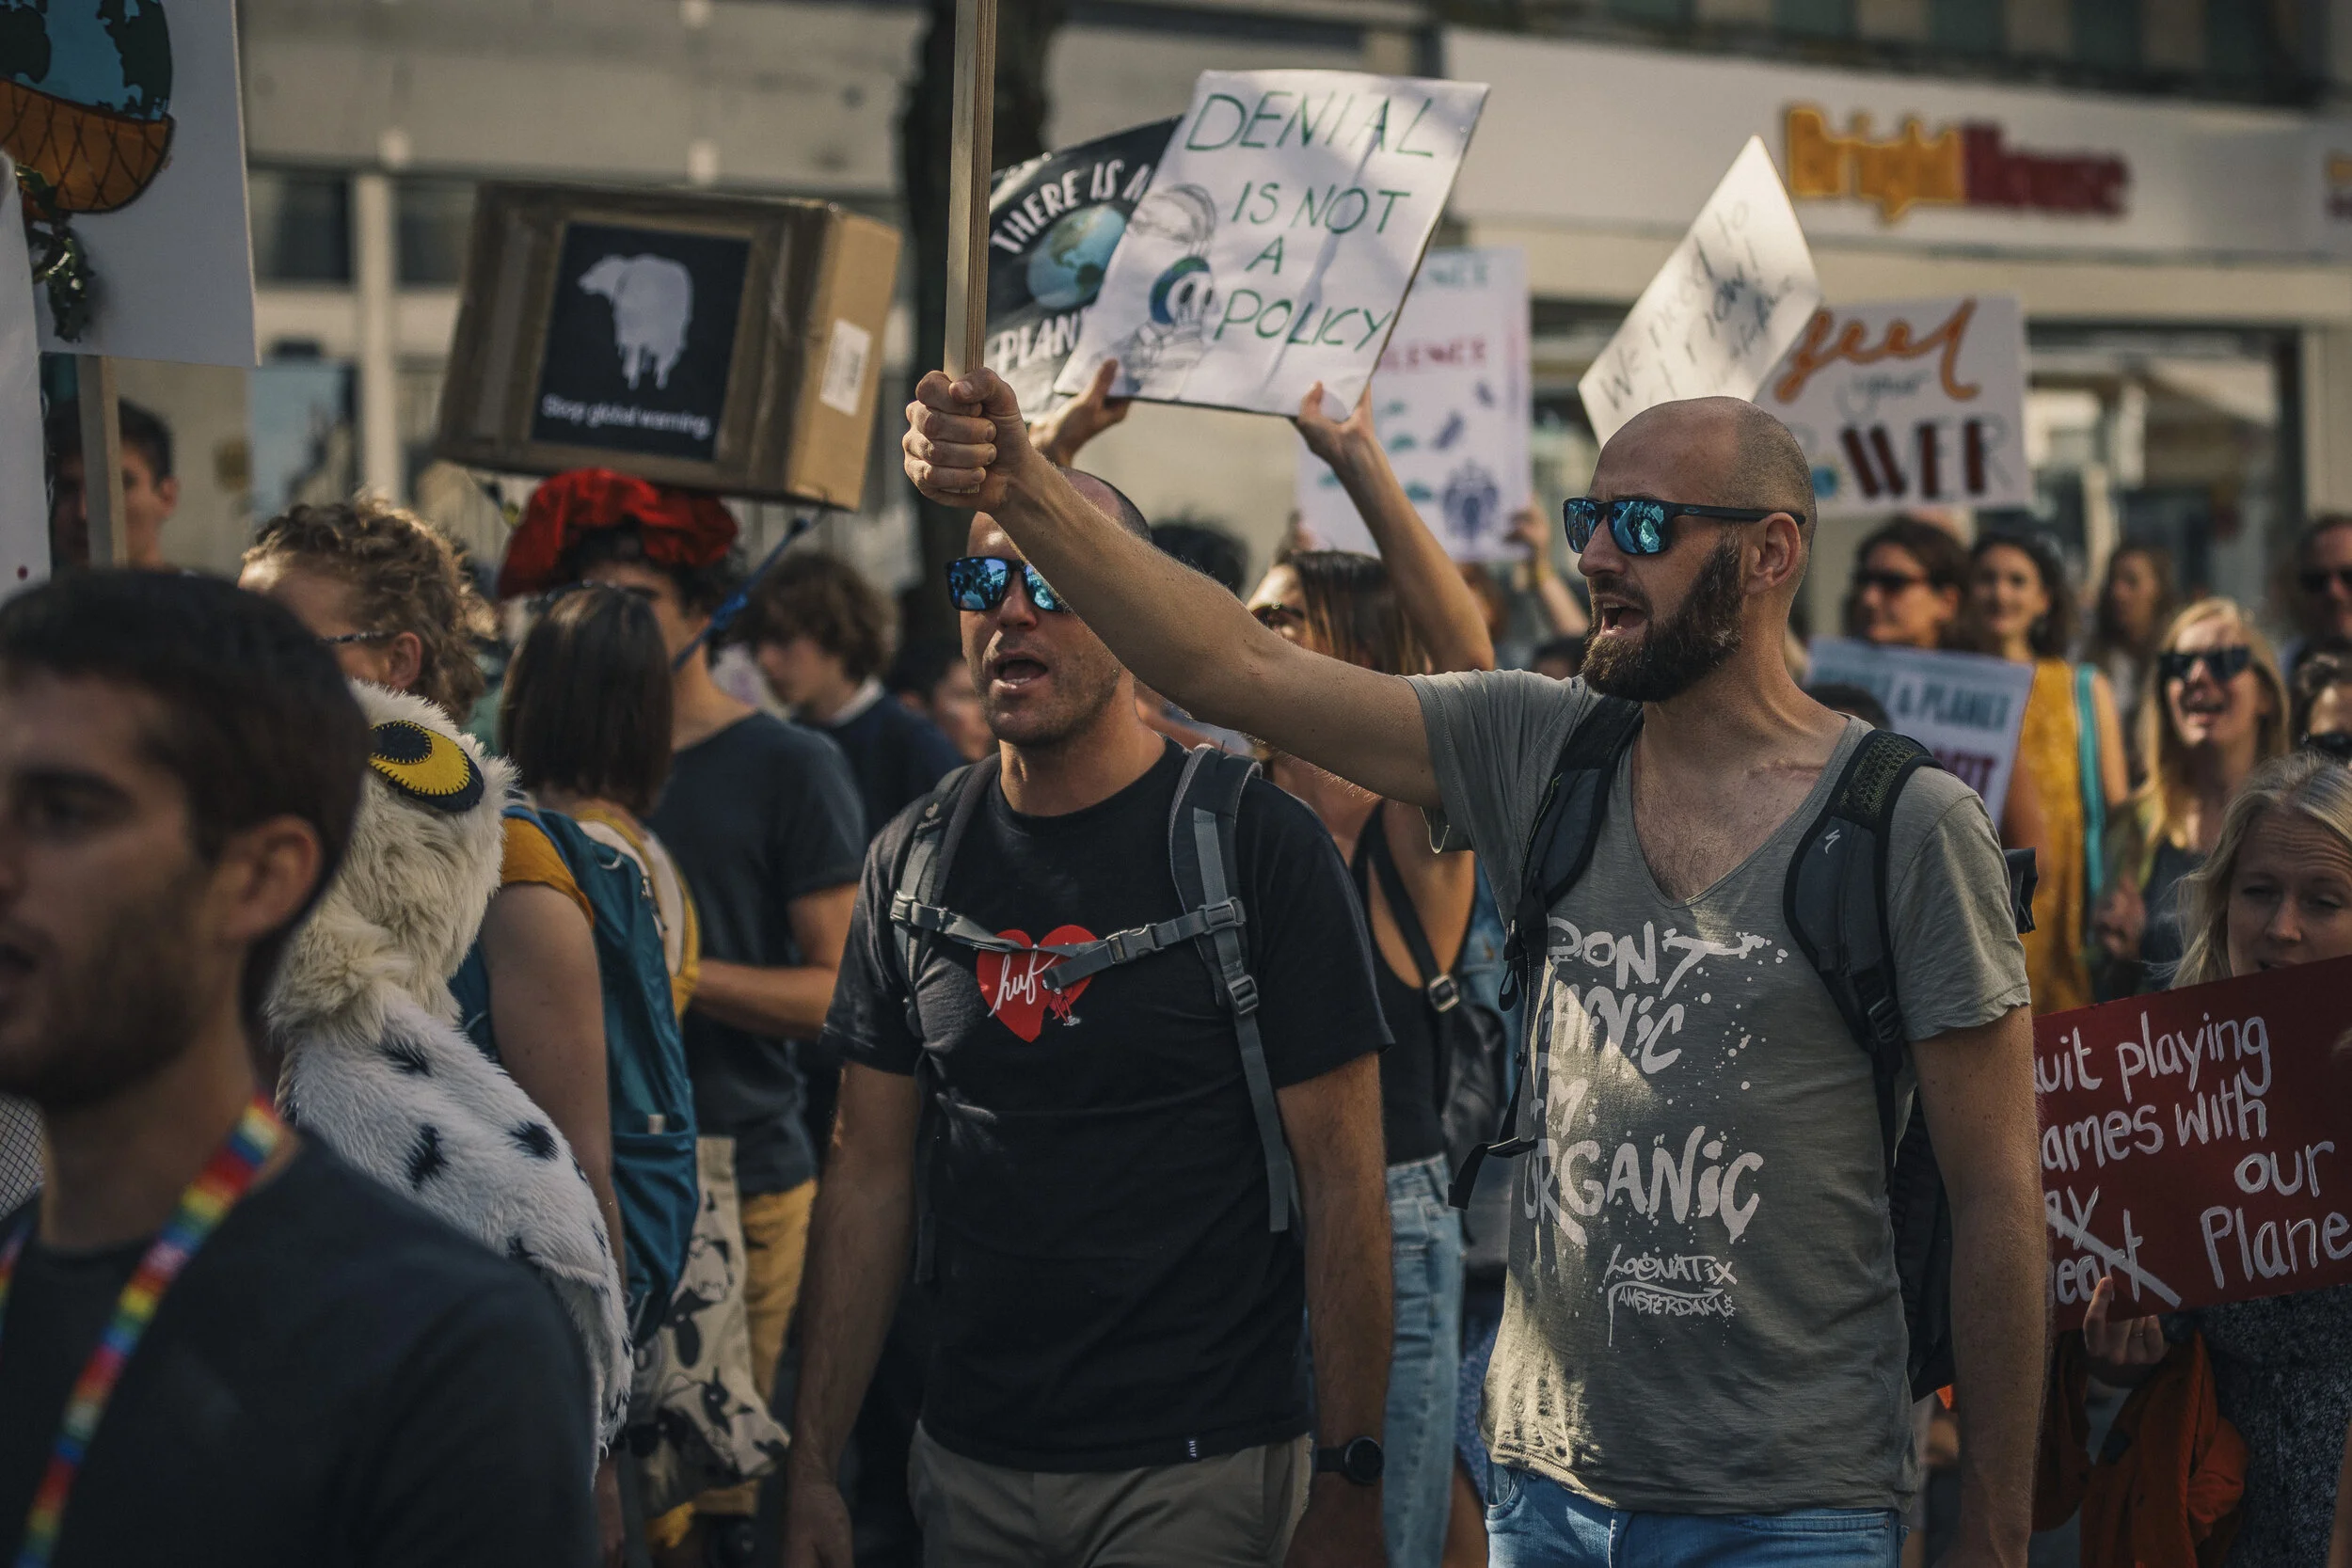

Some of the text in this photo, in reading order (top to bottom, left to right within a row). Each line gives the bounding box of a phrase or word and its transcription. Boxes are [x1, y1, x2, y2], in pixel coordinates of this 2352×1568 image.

[1184, 90, 1434, 158] DENIAL
[990, 167, 1083, 255] THERE
[1089, 158, 1126, 201] IS
[1231, 181, 1411, 235] IS NOT
[1244, 234, 1285, 276] A
[995, 309, 1084, 373] PLAN
[1213, 288, 1393, 354] POLICY
[541, 393, 587, 426] Stop
[586, 401, 637, 429] global
[2033, 1010, 2272, 1104] uit playing
[2042, 1104, 2165, 1173] ames
[2233, 1140, 2336, 1198] our
